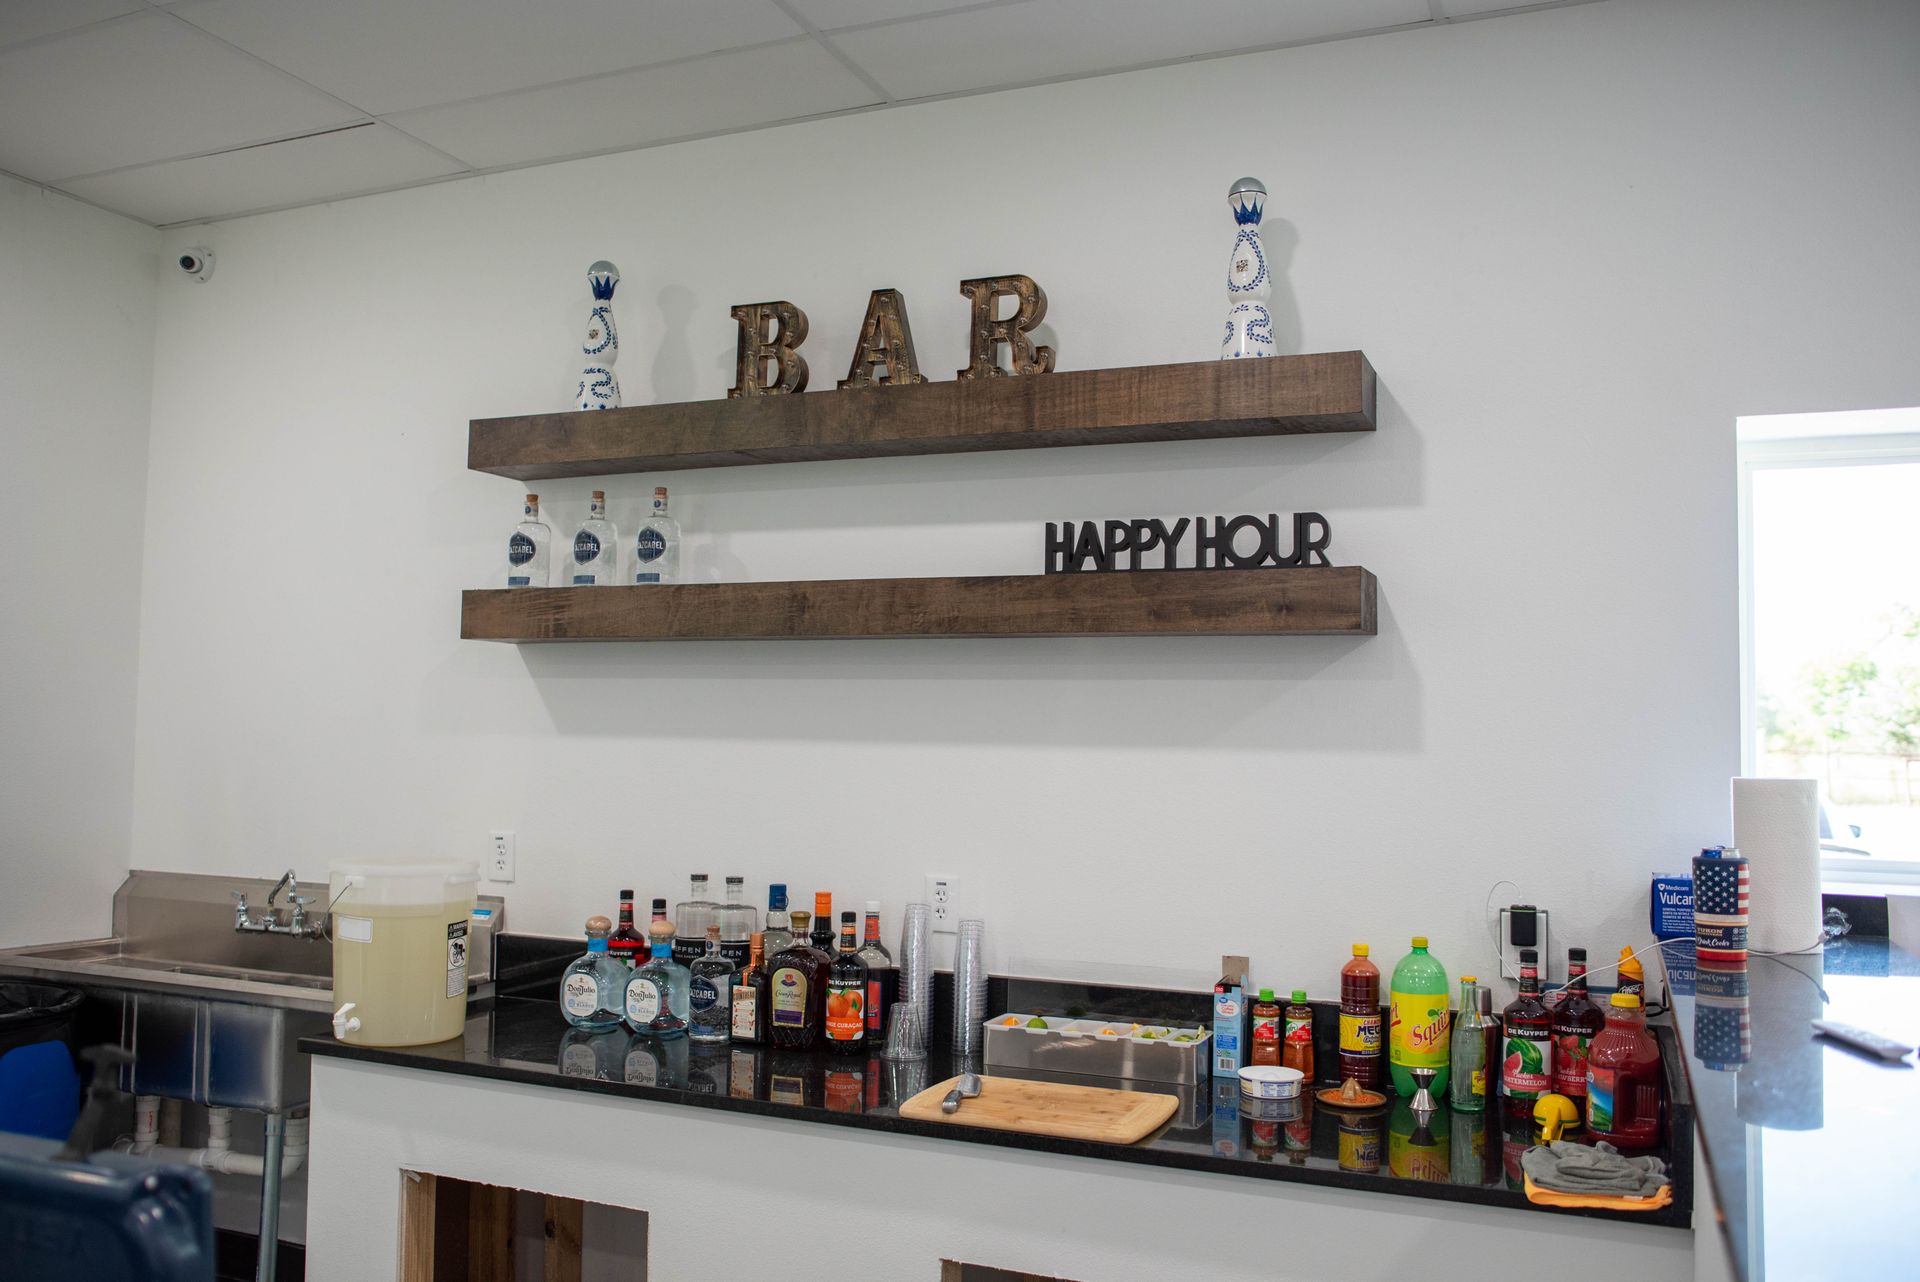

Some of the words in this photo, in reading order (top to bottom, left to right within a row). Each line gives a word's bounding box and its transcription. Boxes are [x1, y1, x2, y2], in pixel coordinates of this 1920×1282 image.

[728, 274, 1056, 400] BAR
[574, 543, 599, 552] AZCABEL
[637, 541, 664, 550] AZCABEL
[1045, 517, 1191, 573] HAPPY
[1196, 512, 1333, 570] HOUR
[509, 545, 533, 554] AZCABEL
[1711, 938, 1730, 946] Cooler
[567, 984, 581, 993] Don
[579, 985, 596, 995] Julio
[689, 989, 717, 999] AZCABEL
[629, 989, 643, 998] Don
[641, 991, 656, 1001] Julio
[1356, 1025, 1380, 1038] MEG
[1412, 1007, 1450, 1046] Squir
[1560, 1025, 1593, 1034] KUYPER
[1517, 1029, 1549, 1037] KUYPER
